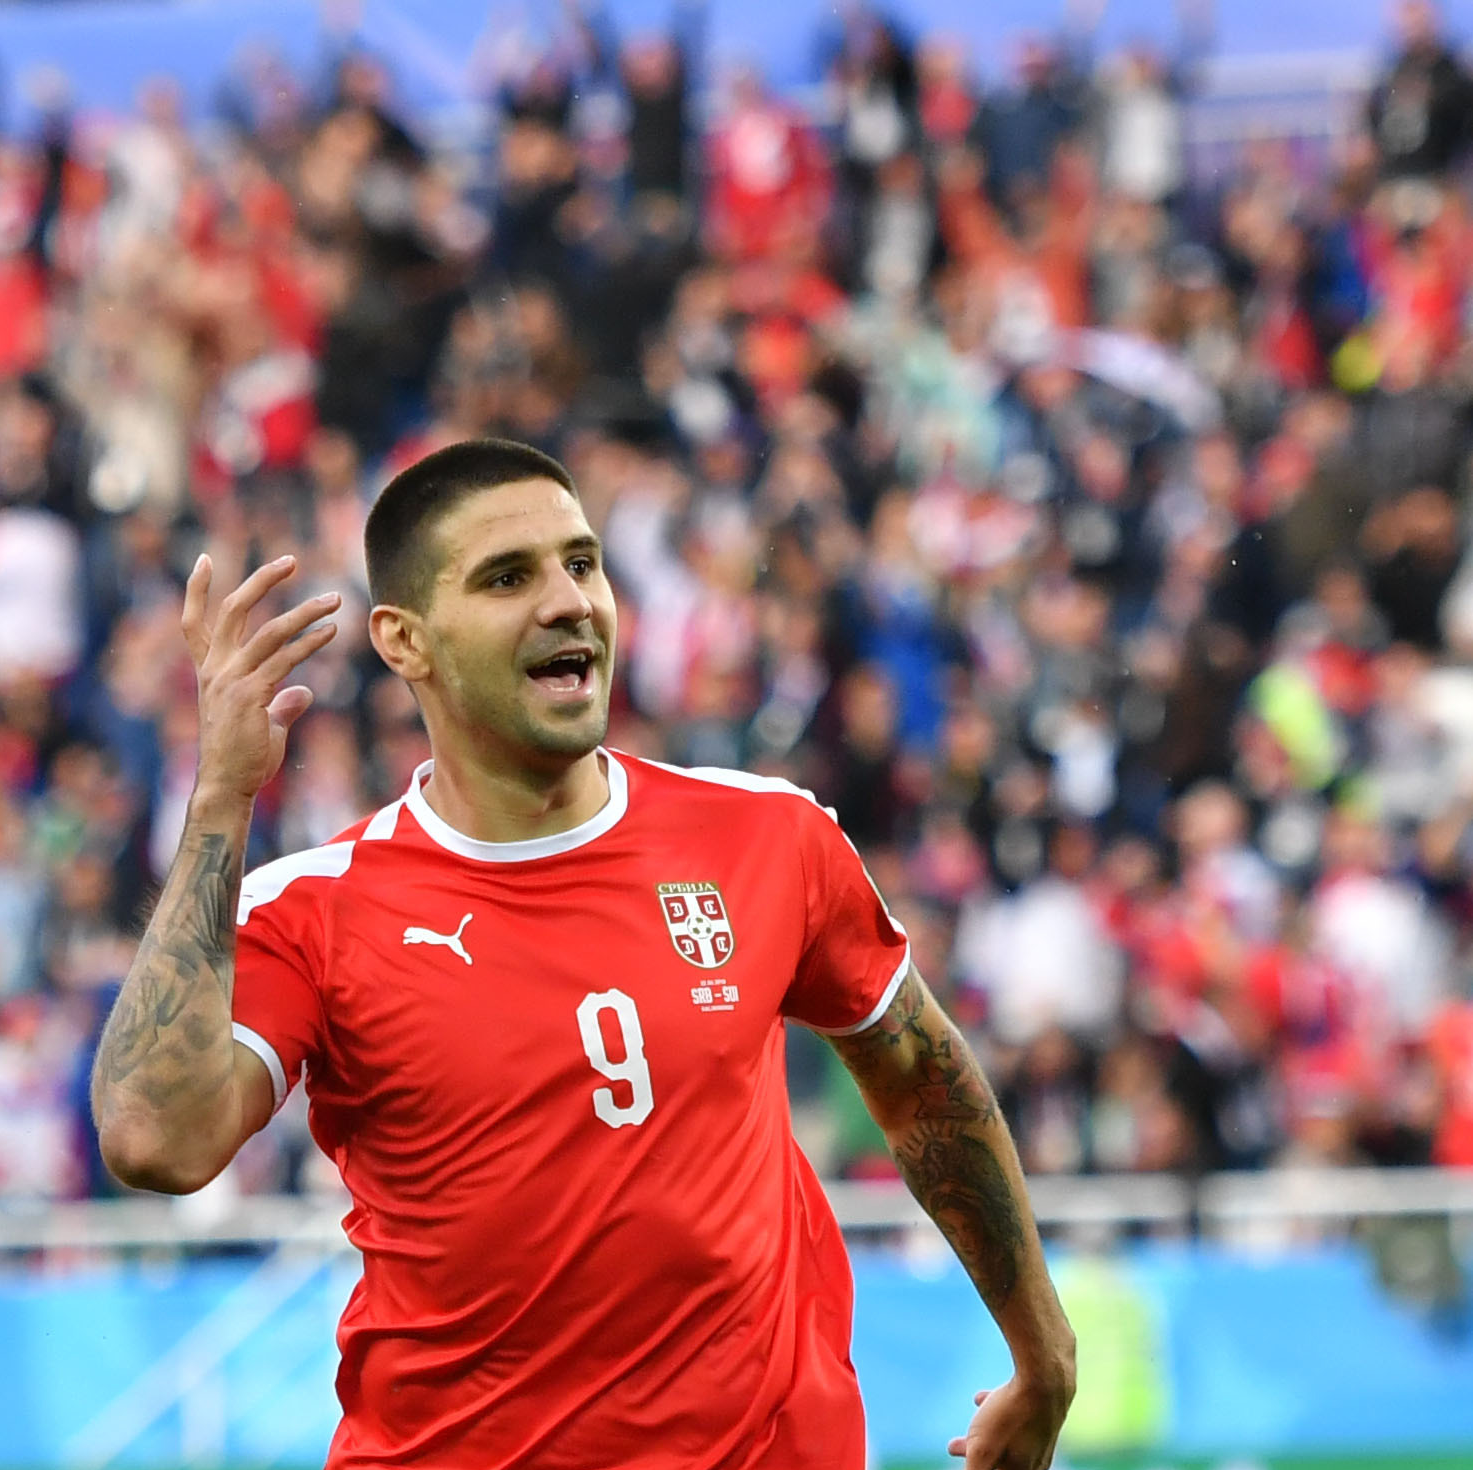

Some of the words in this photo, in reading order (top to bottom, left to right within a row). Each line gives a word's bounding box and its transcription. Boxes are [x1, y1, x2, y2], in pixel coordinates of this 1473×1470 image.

[657, 882, 715, 894] СРБИЈА
[690, 986, 714, 1005] SRB
[722, 985, 740, 1003] SUI
[576, 988, 654, 1129] 9
